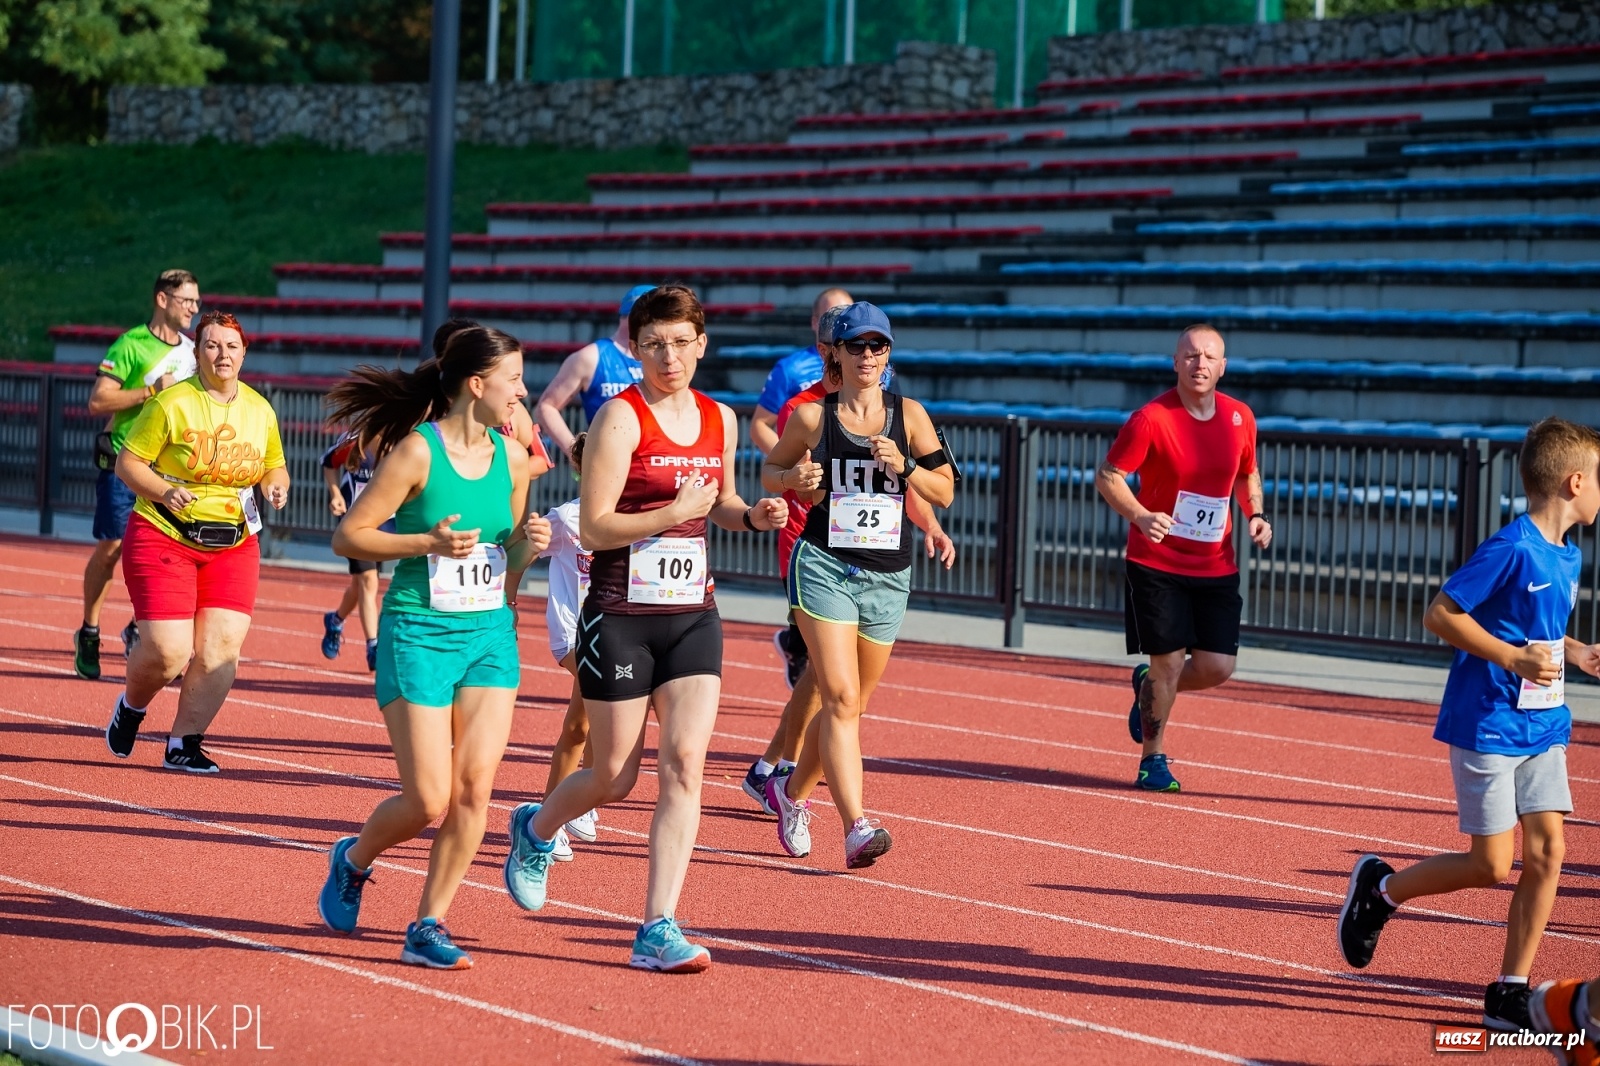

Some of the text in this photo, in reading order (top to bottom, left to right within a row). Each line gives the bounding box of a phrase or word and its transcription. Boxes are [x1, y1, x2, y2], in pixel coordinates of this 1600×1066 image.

[183, 423, 260, 470] Noga
[651, 456, 722, 468] DAR-BUD
[832, 459, 900, 494] LET'S
[857, 509, 880, 528] 25
[1196, 509, 1214, 525] 91
[456, 563, 492, 586] 110
[658, 557, 693, 580] 109
